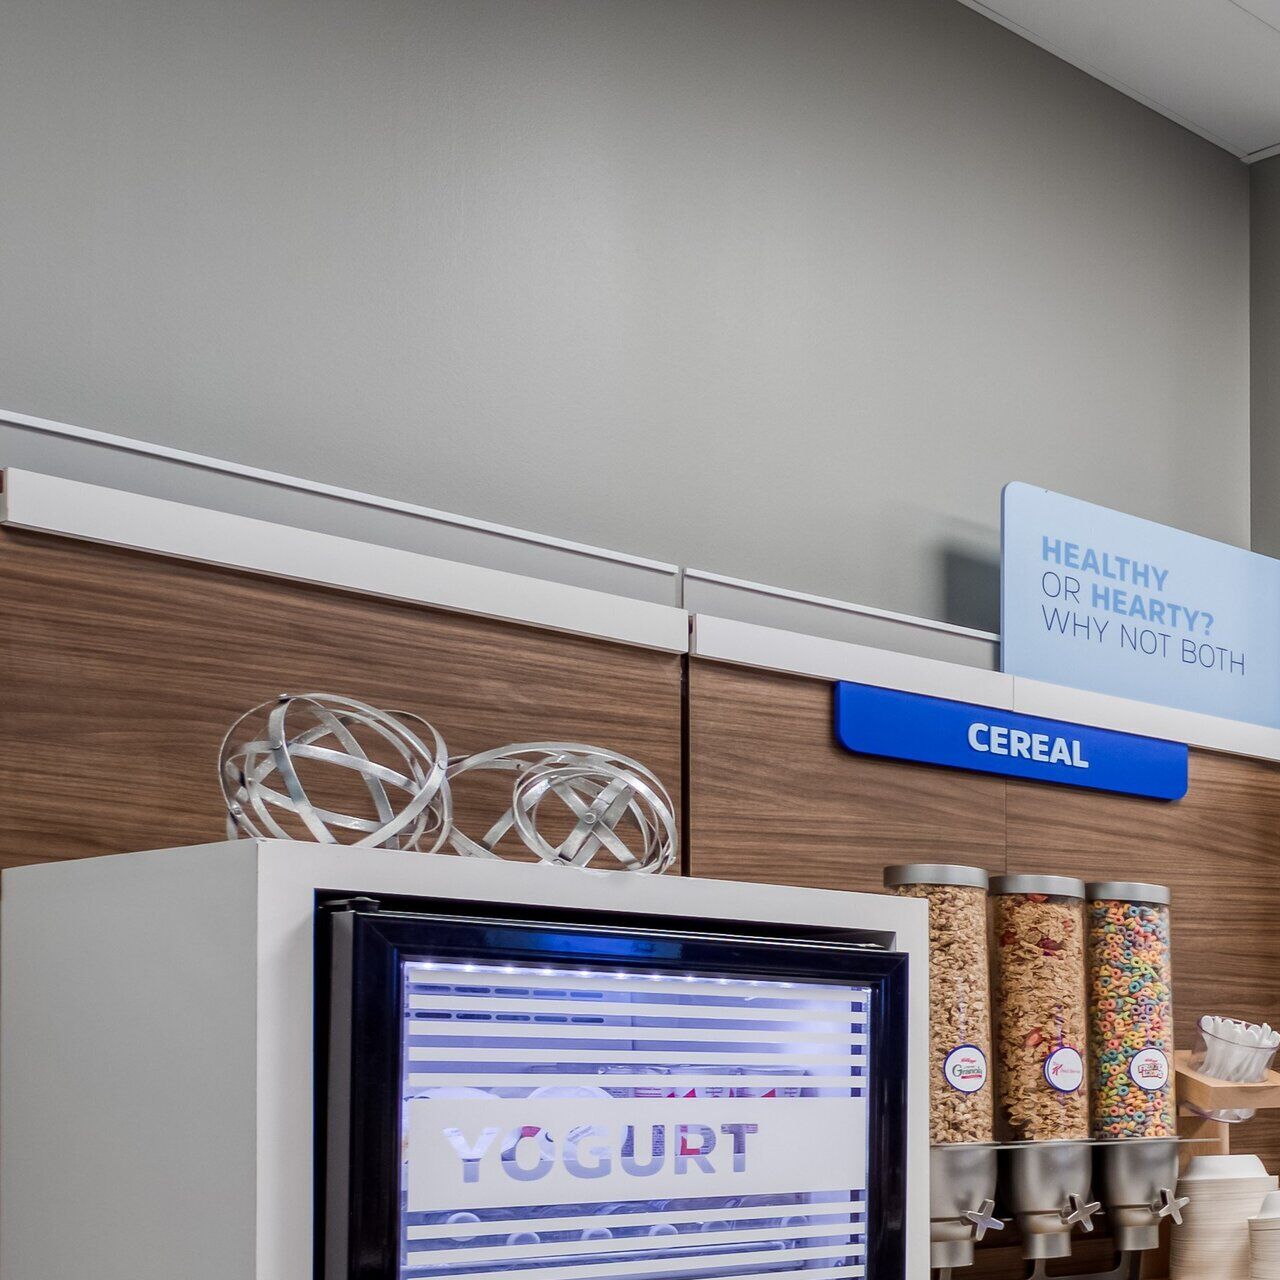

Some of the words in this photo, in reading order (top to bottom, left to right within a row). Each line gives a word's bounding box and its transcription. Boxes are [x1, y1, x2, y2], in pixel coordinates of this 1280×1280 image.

[1042, 535, 1169, 591] HEALTHY
[1042, 571, 1080, 604] OR
[1092, 583, 1214, 636] HEARTY?
[1042, 604, 1109, 643] WHY
[1121, 624, 1171, 658] NOT
[1182, 638, 1245, 676] BOTH
[967, 722, 1089, 768] CEREAL
[442, 1123, 758, 1183] YOGURT
